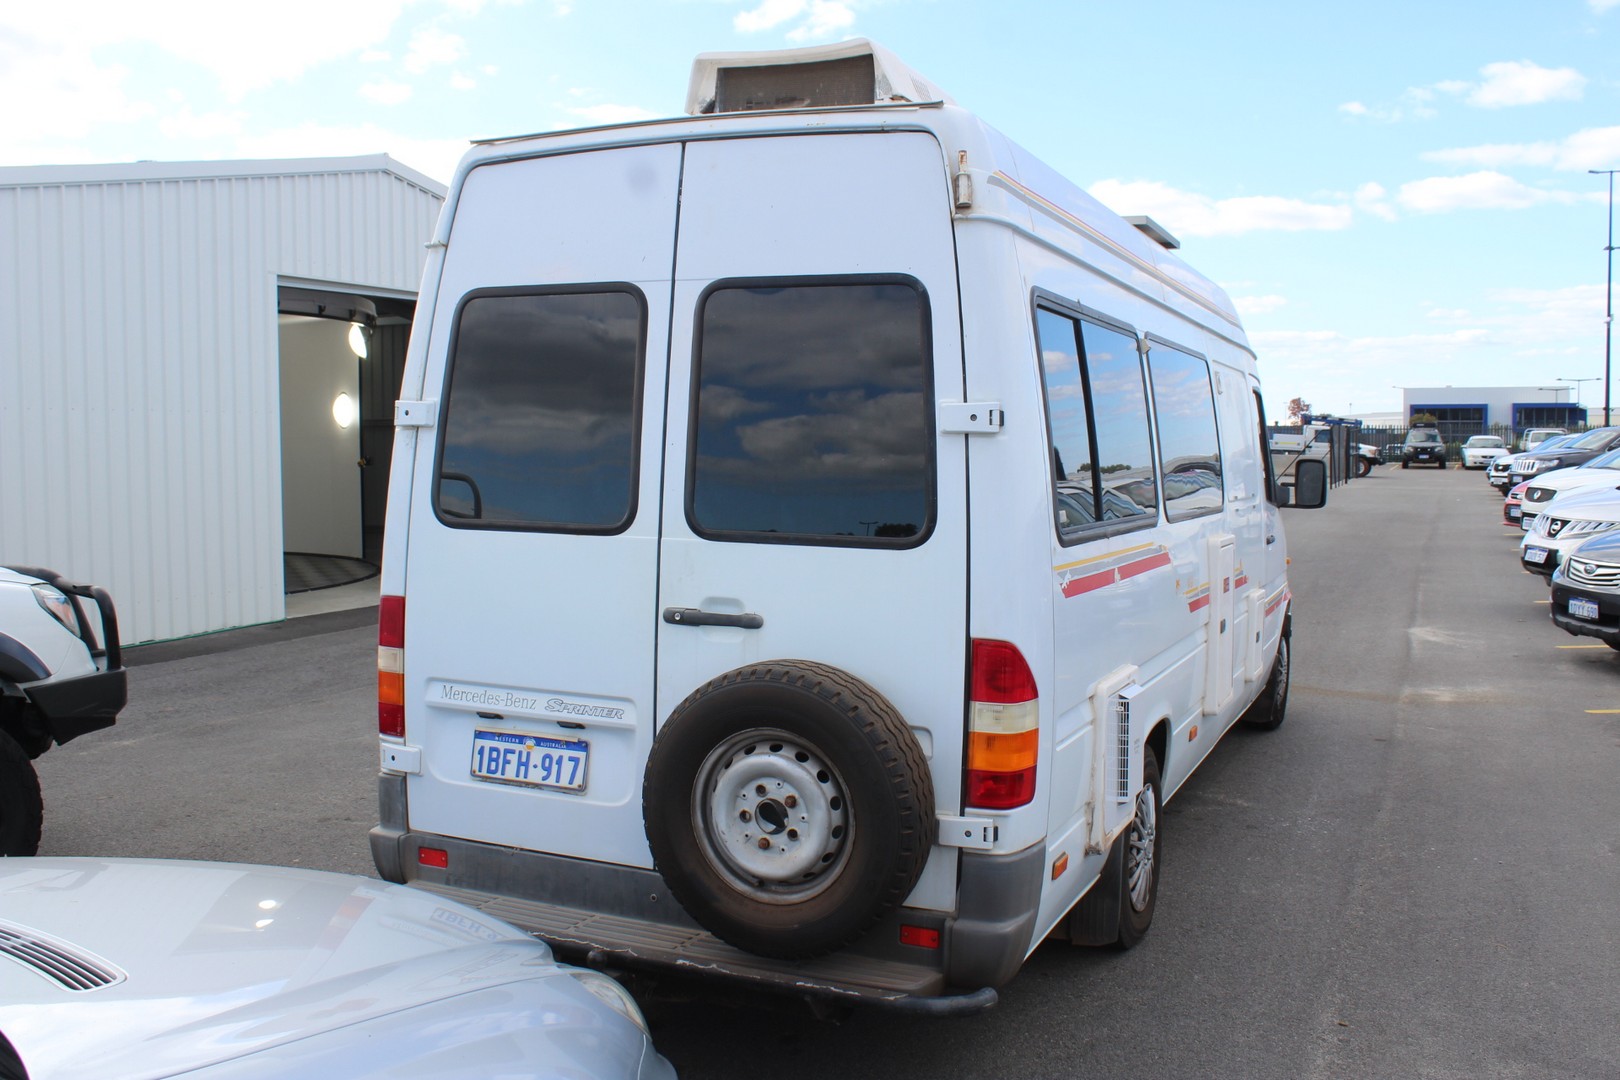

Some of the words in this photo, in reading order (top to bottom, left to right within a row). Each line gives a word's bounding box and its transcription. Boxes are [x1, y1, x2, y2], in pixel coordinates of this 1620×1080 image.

[441, 685, 537, 710] Mercedes-Benz
[545, 698, 625, 720] SPRINTER
[540, 741, 567, 749] AUSTRALIA
